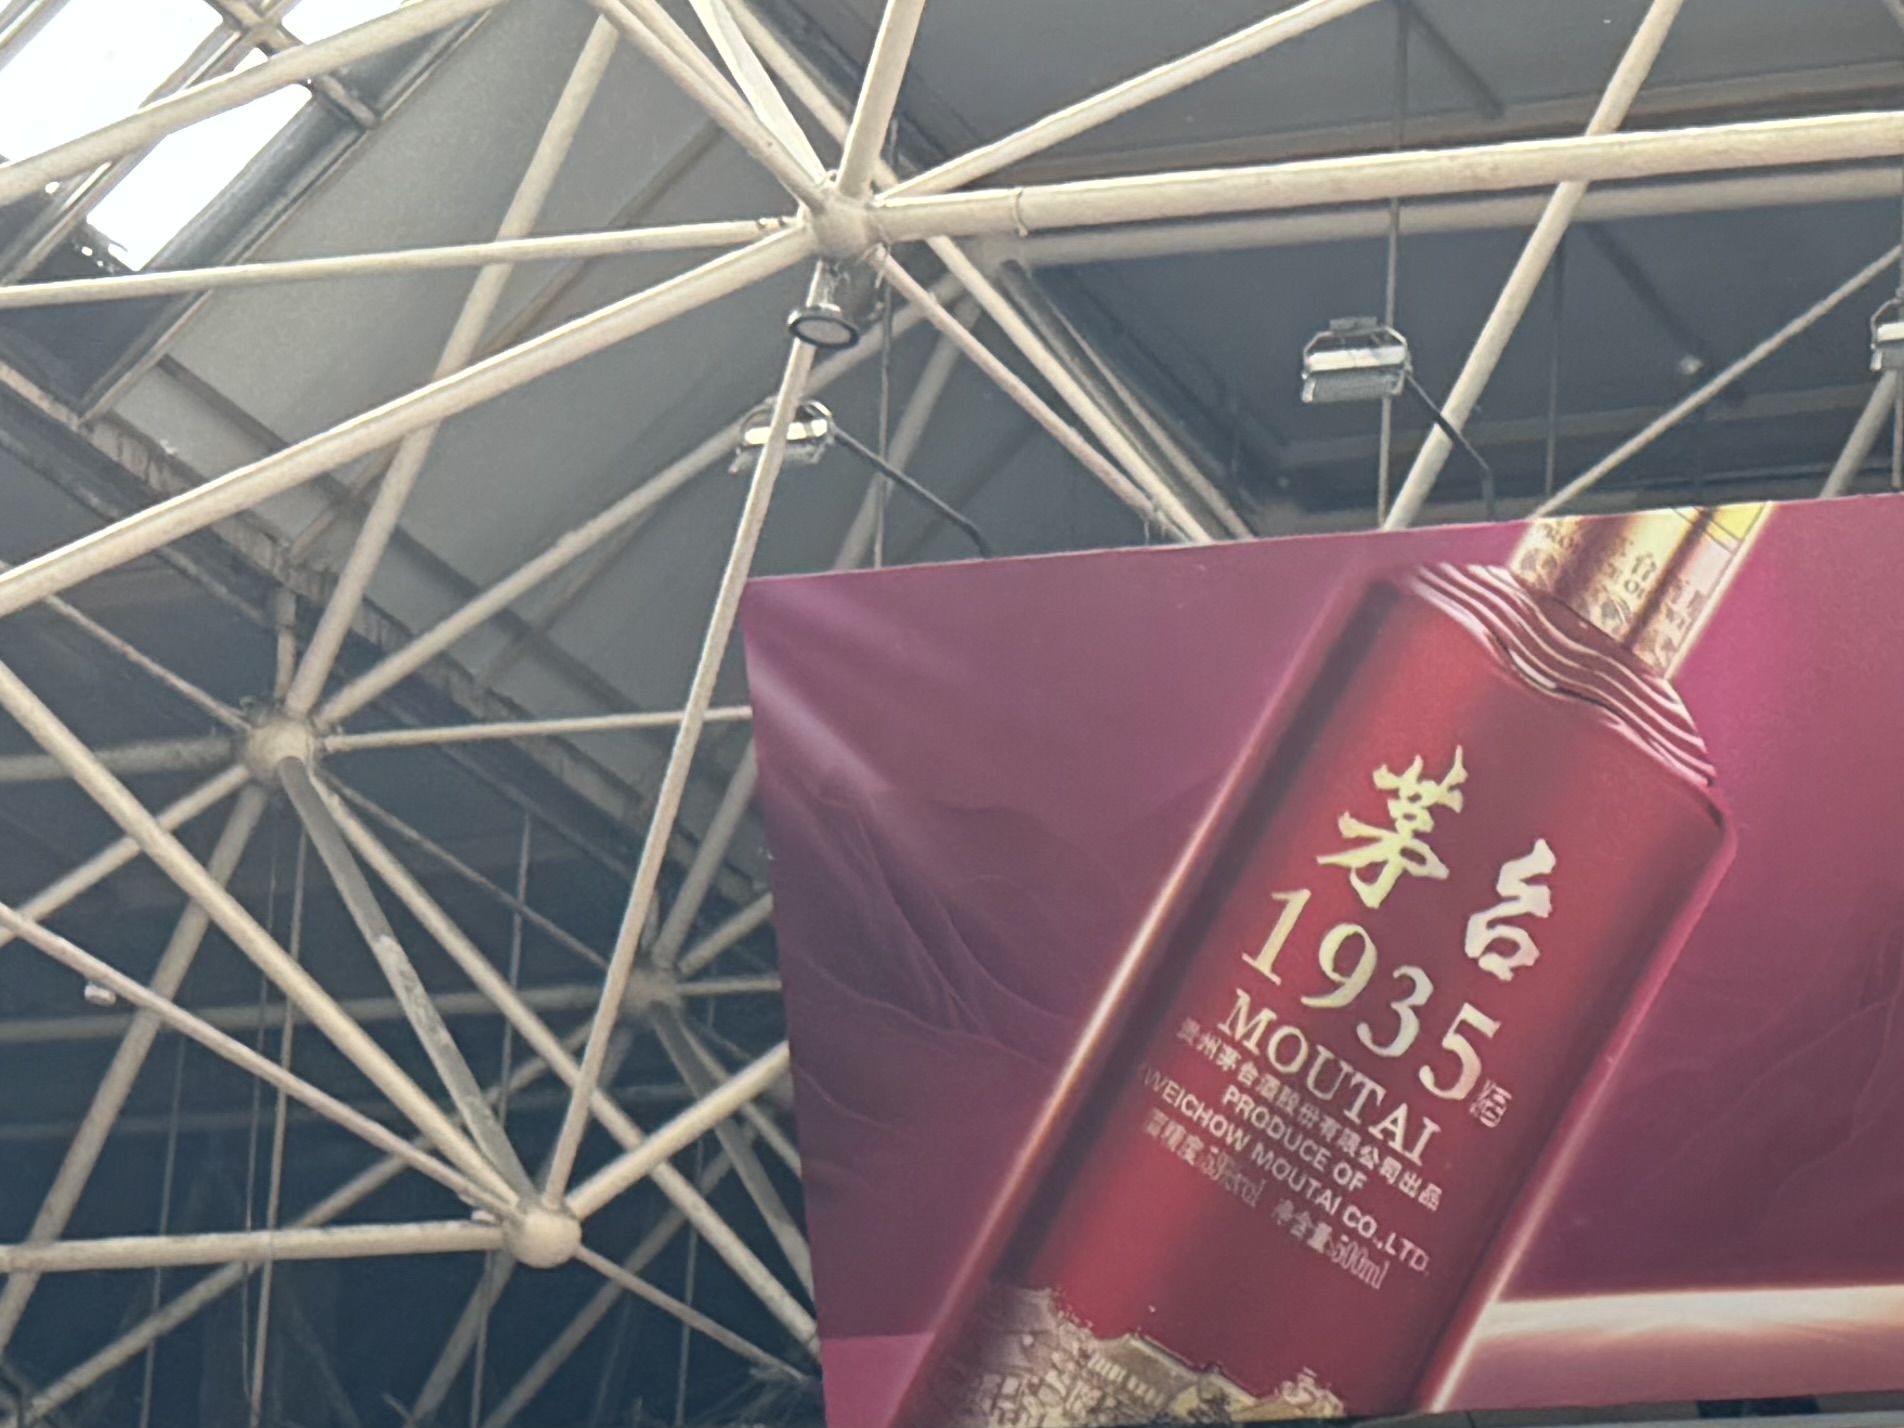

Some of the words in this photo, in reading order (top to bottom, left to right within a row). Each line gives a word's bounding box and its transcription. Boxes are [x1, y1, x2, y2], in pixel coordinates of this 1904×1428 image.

[1317, 744, 1556, 980] 茅台
[1218, 988, 1441, 1166] MOUTAI
[1242, 888, 1500, 1101] 1935
[1222, 1085, 1327, 1172] PRODUCE
[1333, 1157, 1368, 1192] OF
[1252, 1145, 1341, 1214] MOUTAI
